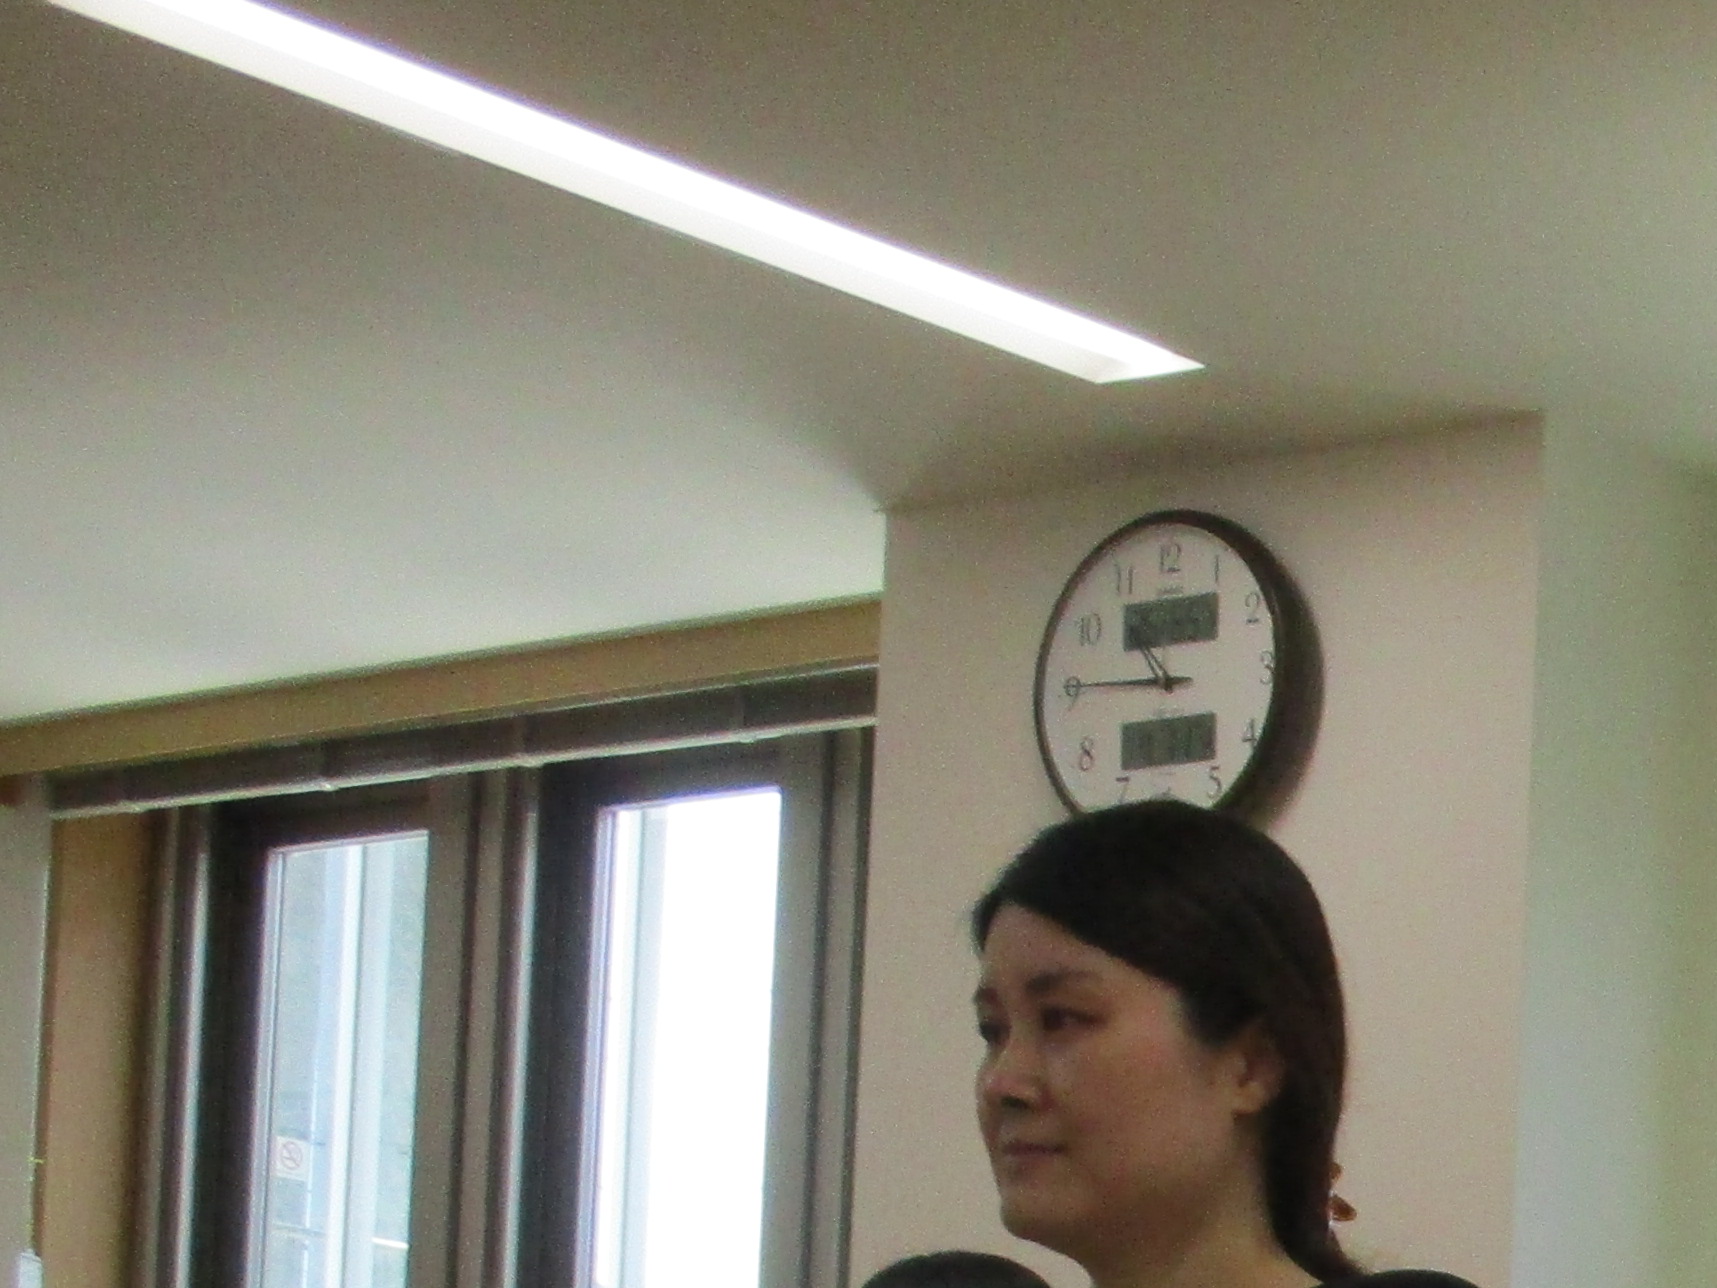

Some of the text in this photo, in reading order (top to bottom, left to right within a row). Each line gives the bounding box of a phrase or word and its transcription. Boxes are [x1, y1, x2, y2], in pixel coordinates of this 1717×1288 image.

[1159, 542, 1182, 573] 12
[1114, 562, 1134, 594] 11
[1077, 612, 1101, 646] 10
[1259, 650, 1275, 686] 3
[1242, 718, 1257, 746] 4
[1079, 737, 1095, 771] 8
[1207, 765, 1222, 799] 5
